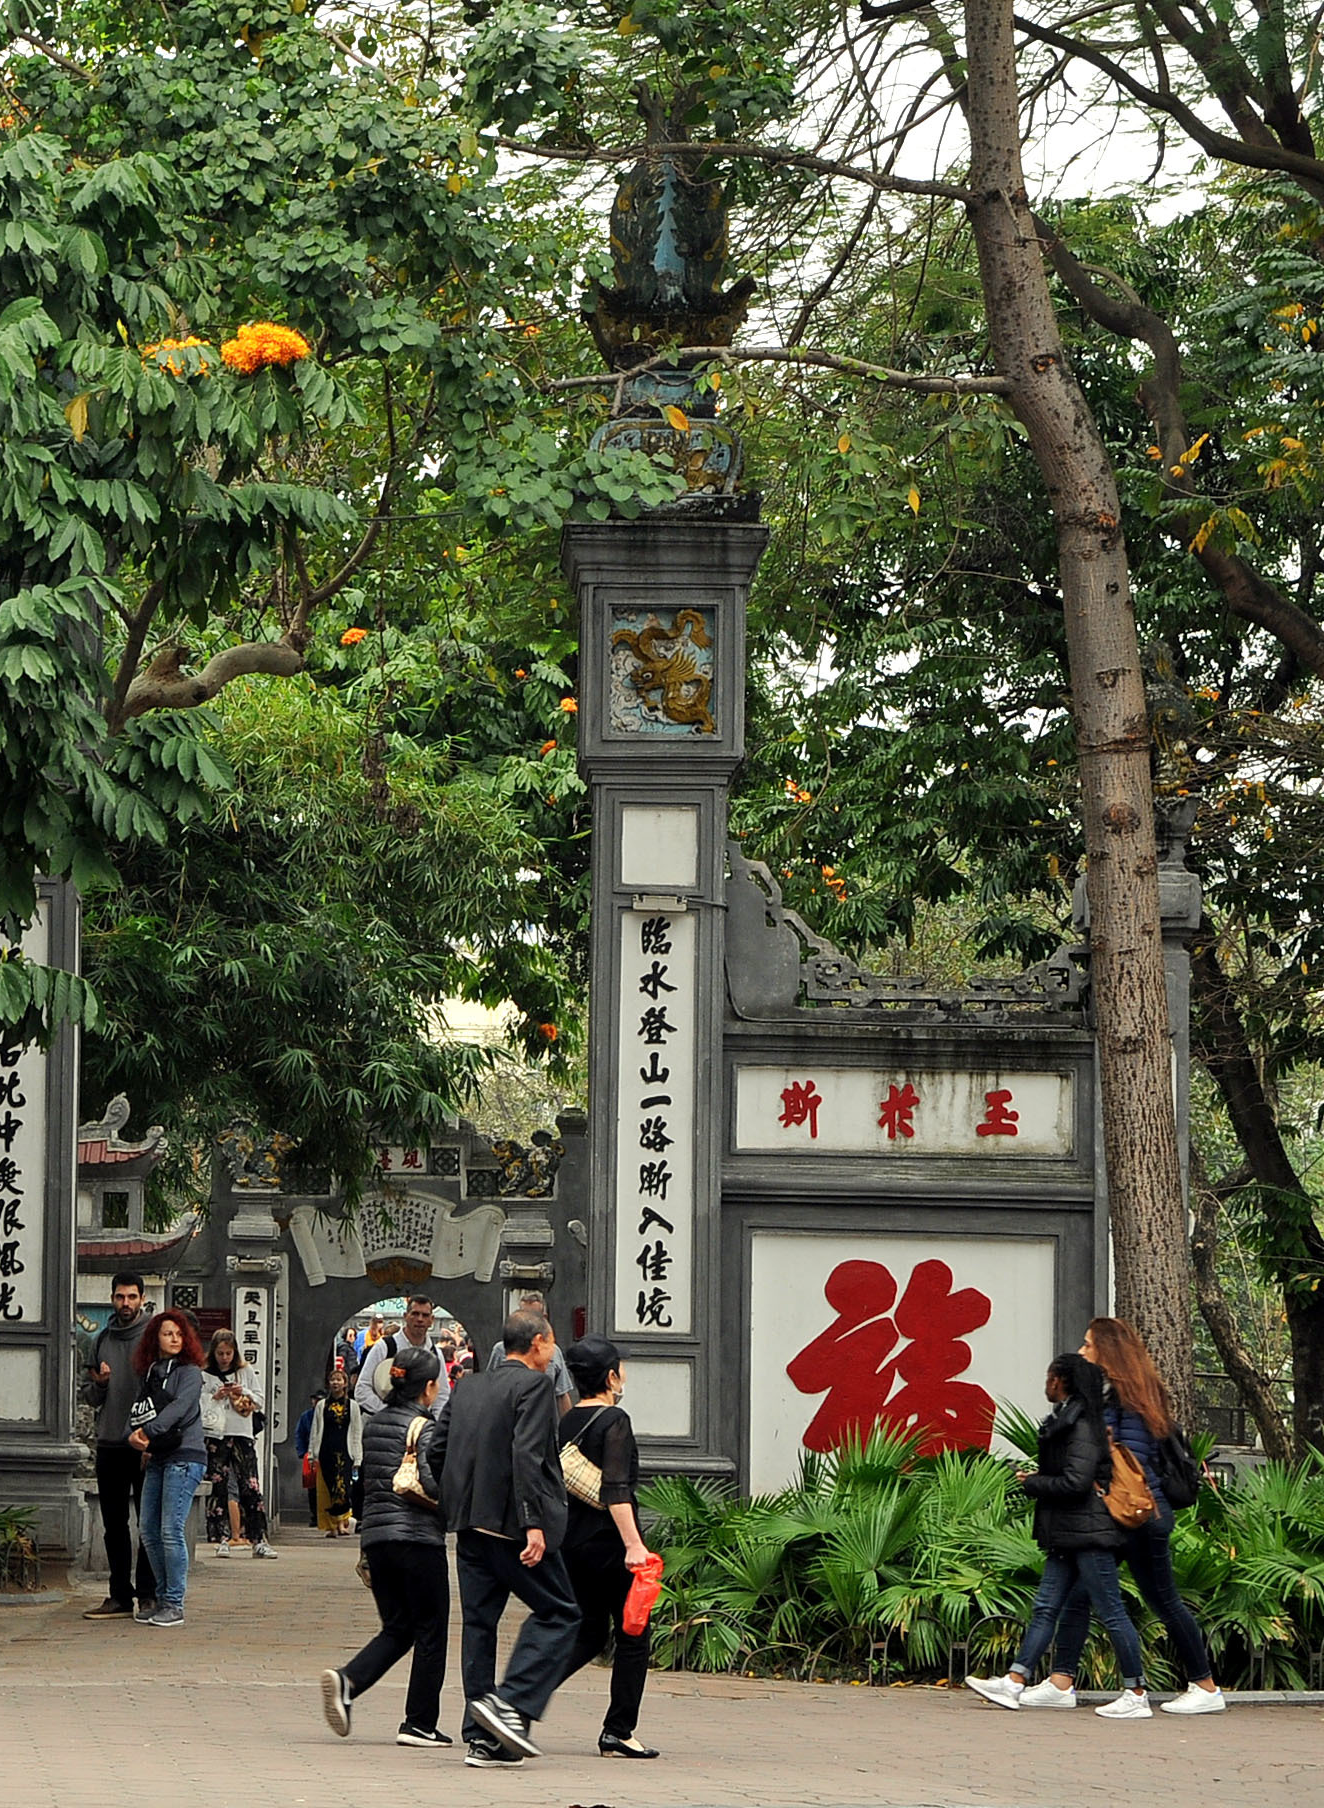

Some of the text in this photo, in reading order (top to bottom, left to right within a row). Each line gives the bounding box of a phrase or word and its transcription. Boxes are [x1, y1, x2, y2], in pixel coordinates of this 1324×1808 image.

[636, 915, 678, 1328] 臨水登山一路漸入佳境
